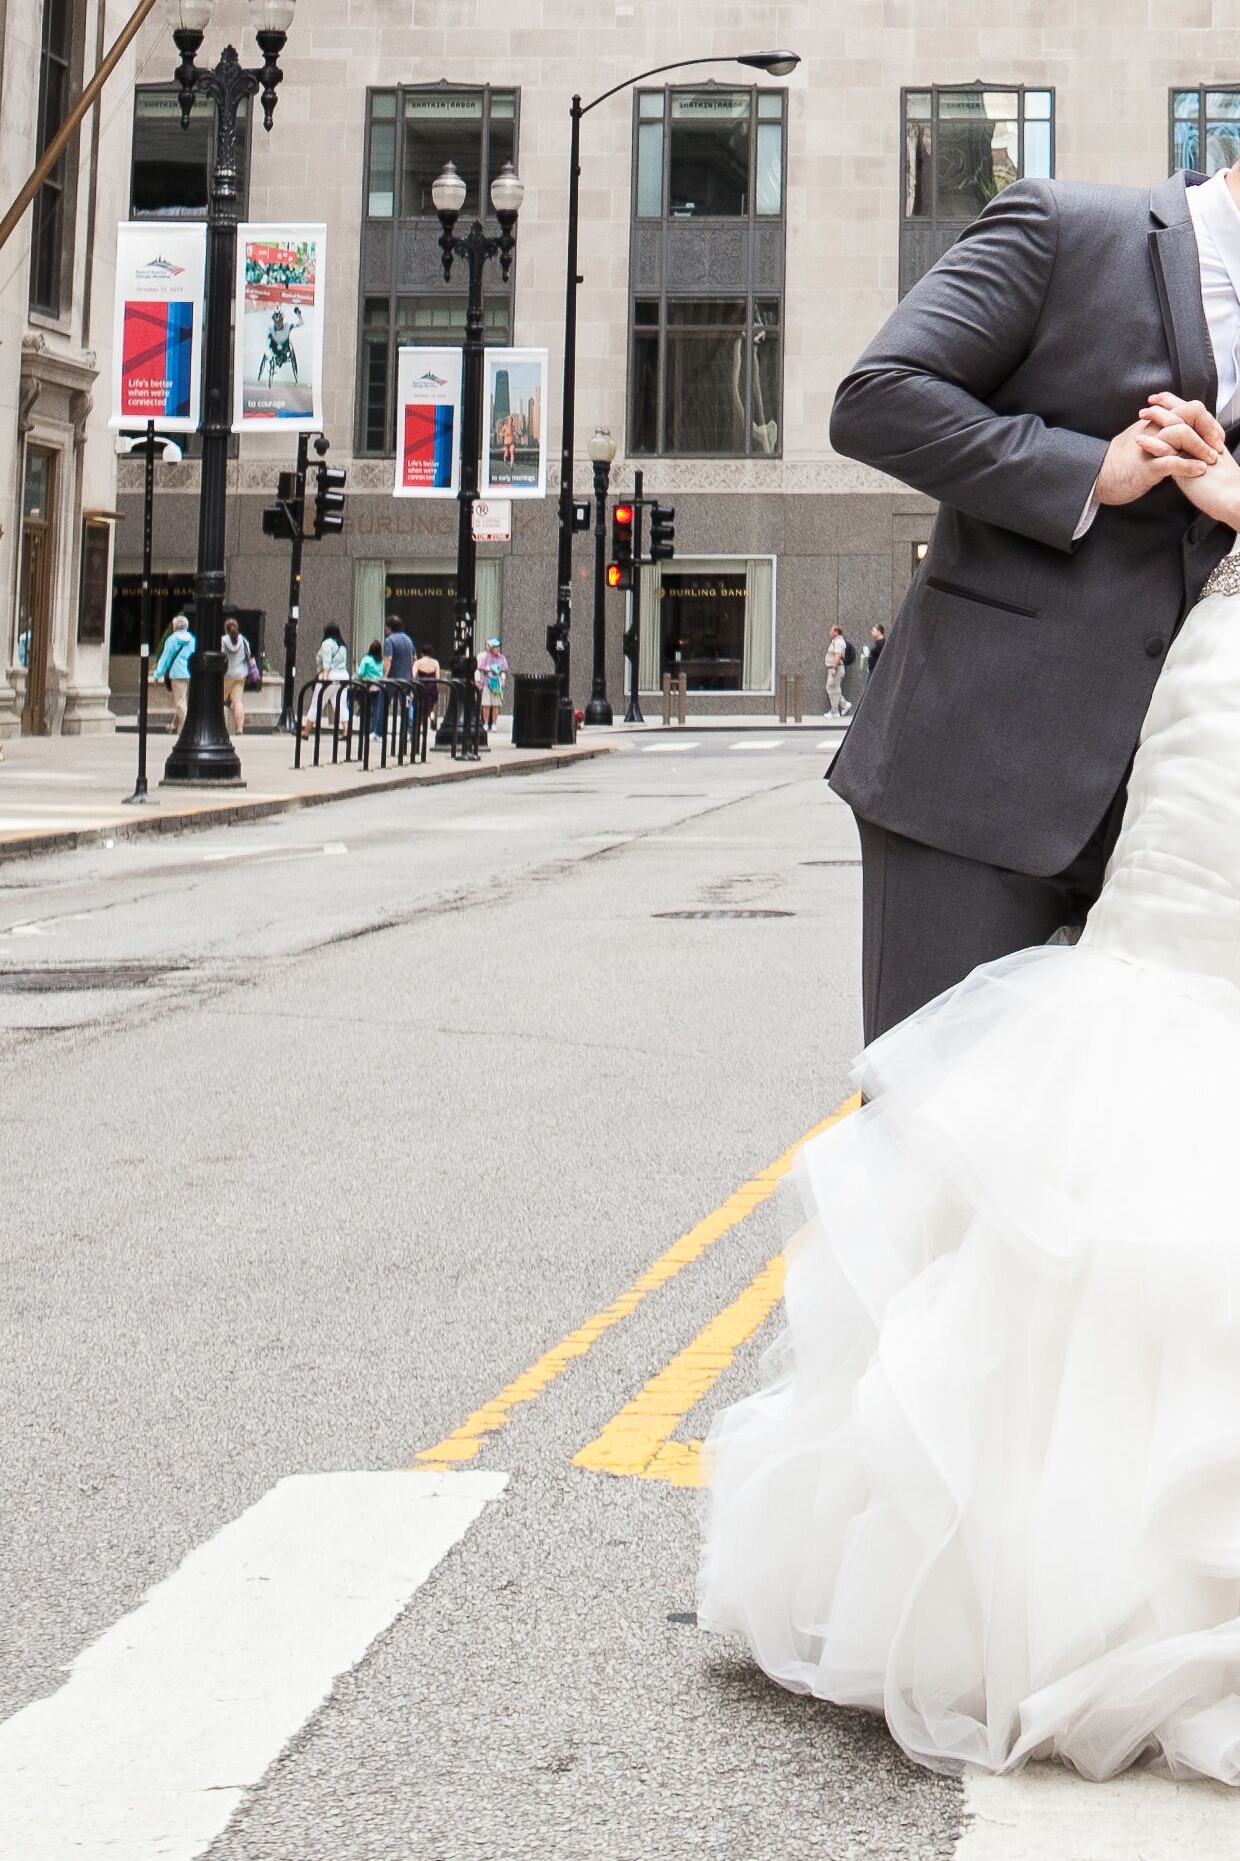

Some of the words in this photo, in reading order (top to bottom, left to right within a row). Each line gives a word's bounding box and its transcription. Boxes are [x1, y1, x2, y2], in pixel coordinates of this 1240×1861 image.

[128, 379, 149, 388] Life's
[150, 379, 174, 388] better
[128, 388, 149, 397] when
[128, 398, 167, 406] connected
[248, 400, 256, 408] to
[257, 400, 286, 409] courage
[122, 587, 169, 596] BURING
[395, 588, 443, 597] BURLING
[669, 588, 716, 597] BURLING
[721, 588, 750, 597] BANK
